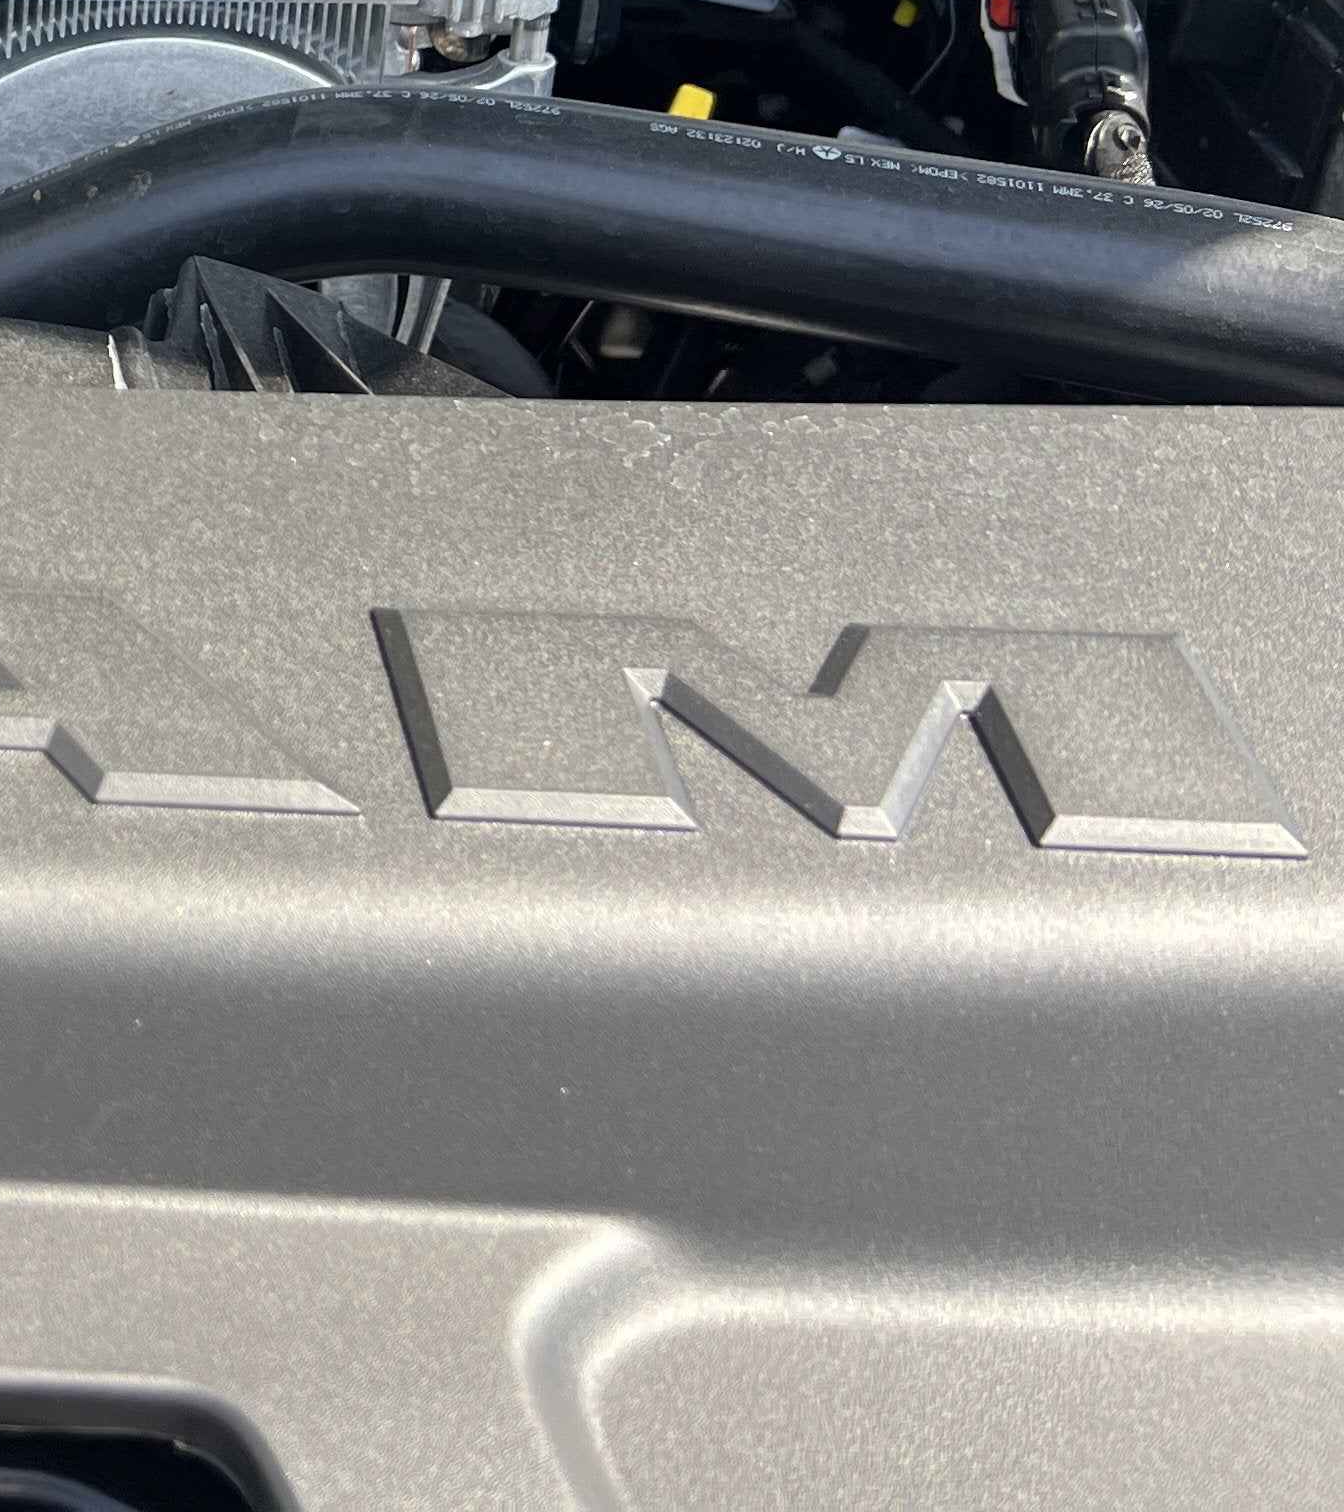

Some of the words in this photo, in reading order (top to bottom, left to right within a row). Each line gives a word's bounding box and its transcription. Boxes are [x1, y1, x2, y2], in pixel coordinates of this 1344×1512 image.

[869, 157, 901, 172] MEX
[1052, 185, 1115, 203] 37.3MM
[1123, 194, 1135, 206] C
[1143, 198, 1224, 220] 02/05/26
[1233, 212, 1294, 232] 97252L
